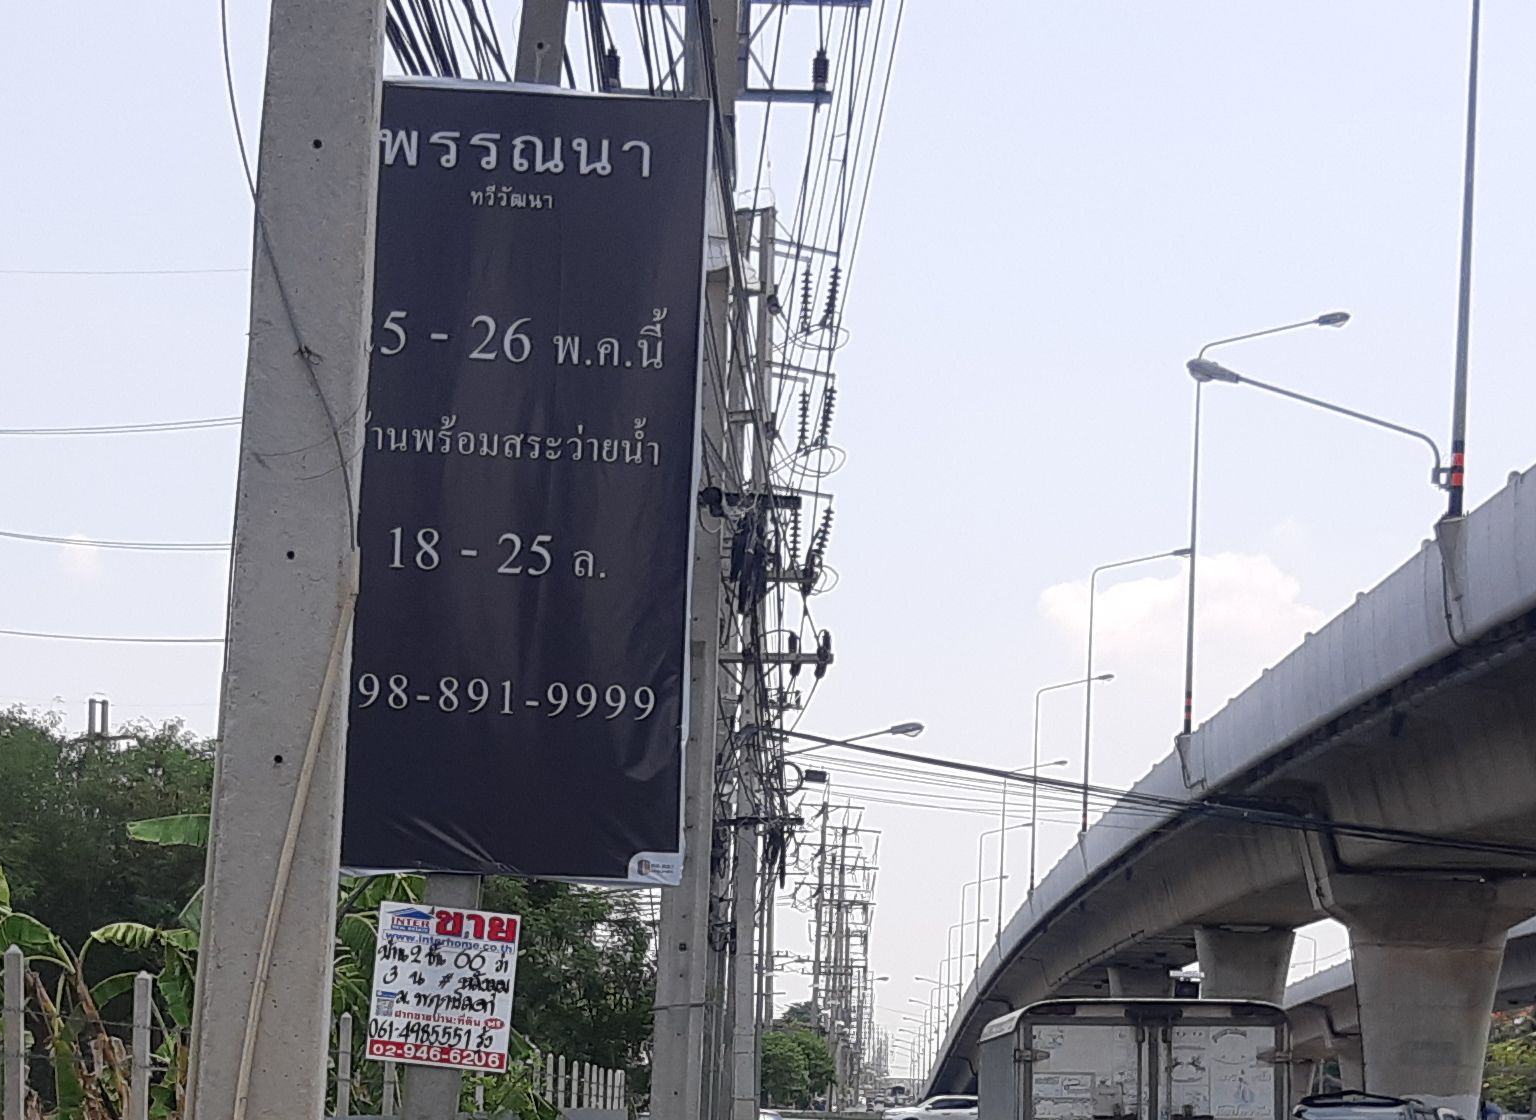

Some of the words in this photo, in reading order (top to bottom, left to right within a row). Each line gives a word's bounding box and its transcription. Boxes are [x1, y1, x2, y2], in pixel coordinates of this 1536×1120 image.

[378, 128, 652, 177] พรรณนา
[470, 184, 553, 209] ทวีวัฒนา
[365, 310, 408, 356] 5
[468, 315, 532, 363] 26
[553, 307, 667, 369] พ.ค.นี้
[364, 410, 660, 466] านพร้อมสระว่ายน้ำ
[388, 527, 441, 571] 18
[496, 533, 553, 576] 25
[572, 549, 607, 578] ล.
[391, 916, 430, 927] INTER
[435, 910, 517, 943] ขาย
[385, 932, 513, 954] www.interhome.co.th
[373, 1043, 500, 1068] 02-946-6206
